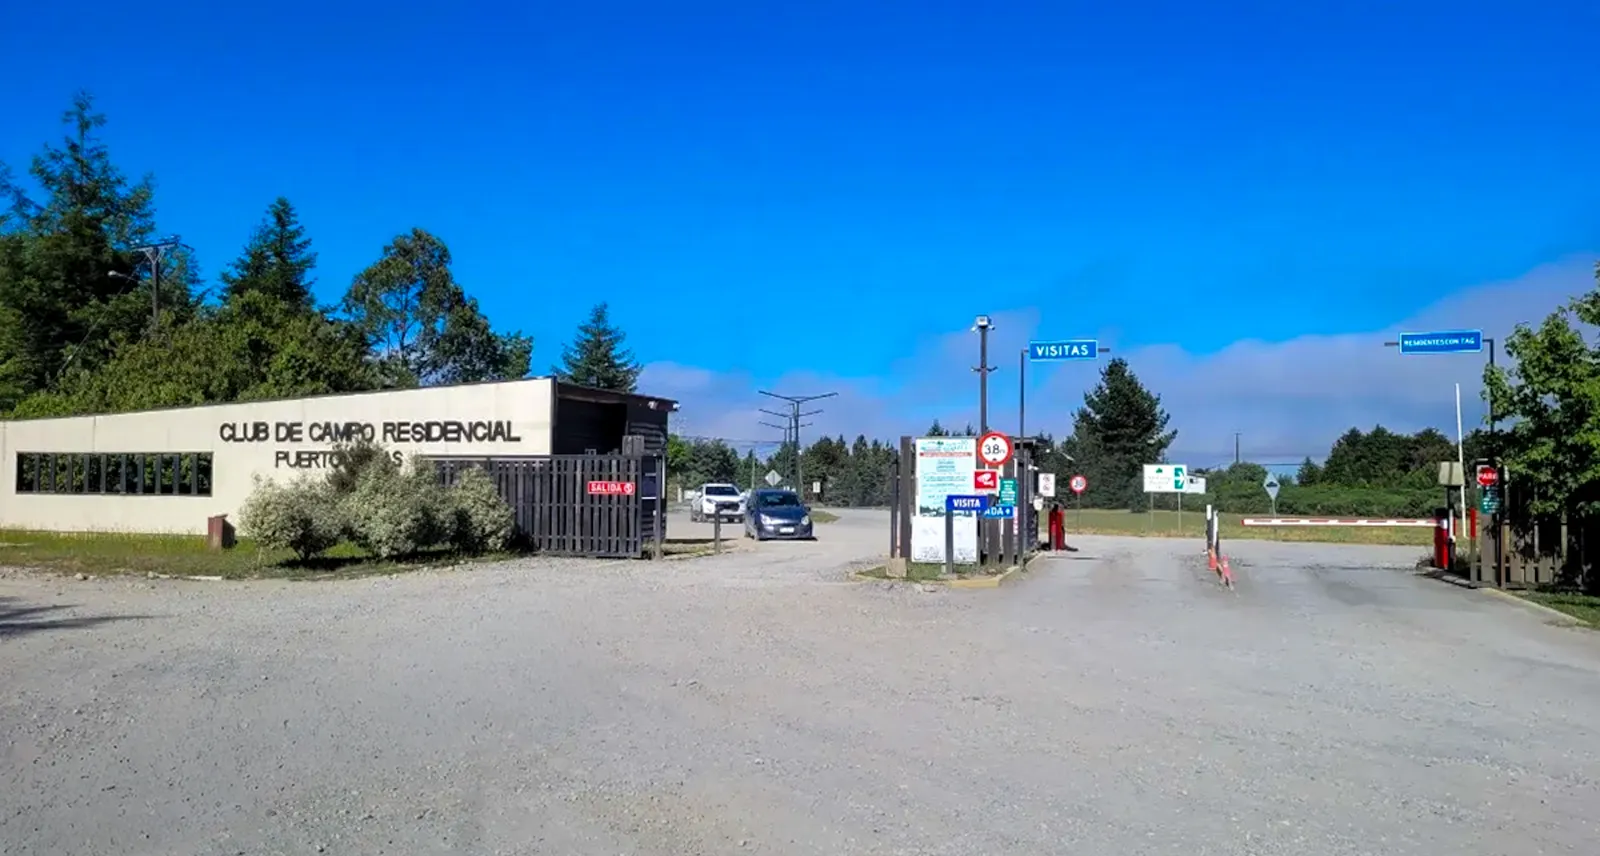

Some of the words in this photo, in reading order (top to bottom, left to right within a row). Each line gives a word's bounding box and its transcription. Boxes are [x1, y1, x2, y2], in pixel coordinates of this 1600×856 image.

[1461, 337, 1475, 345] TAG
[1036, 345, 1088, 356] VISITAS
[219, 421, 270, 442] CLUB
[275, 421, 303, 442] DE
[308, 421, 375, 442] CAMPO
[382, 420, 522, 443] RESIDENCIAL
[275, 450, 348, 468] PUERTO
[591, 483, 622, 492] SALIDA
[952, 498, 981, 508] VISITA
